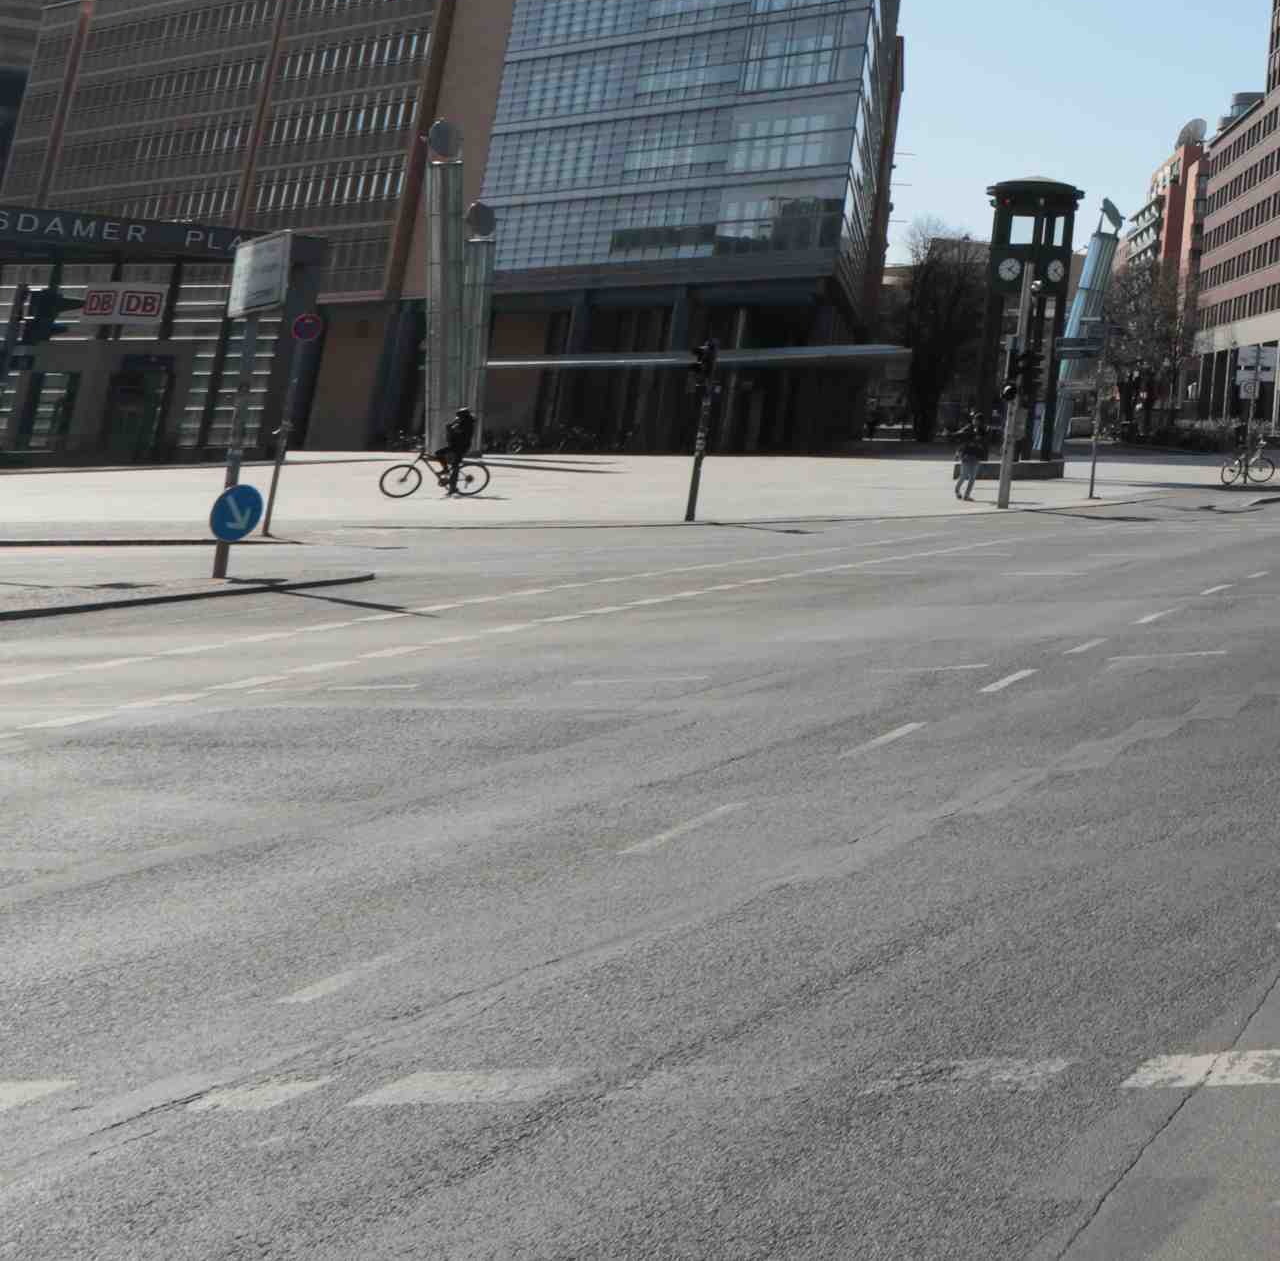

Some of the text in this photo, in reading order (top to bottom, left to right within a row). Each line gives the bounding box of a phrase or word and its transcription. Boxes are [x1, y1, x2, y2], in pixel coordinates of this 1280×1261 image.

[184, 230, 242, 251] PLA
[87, 293, 158, 314] DB DB
